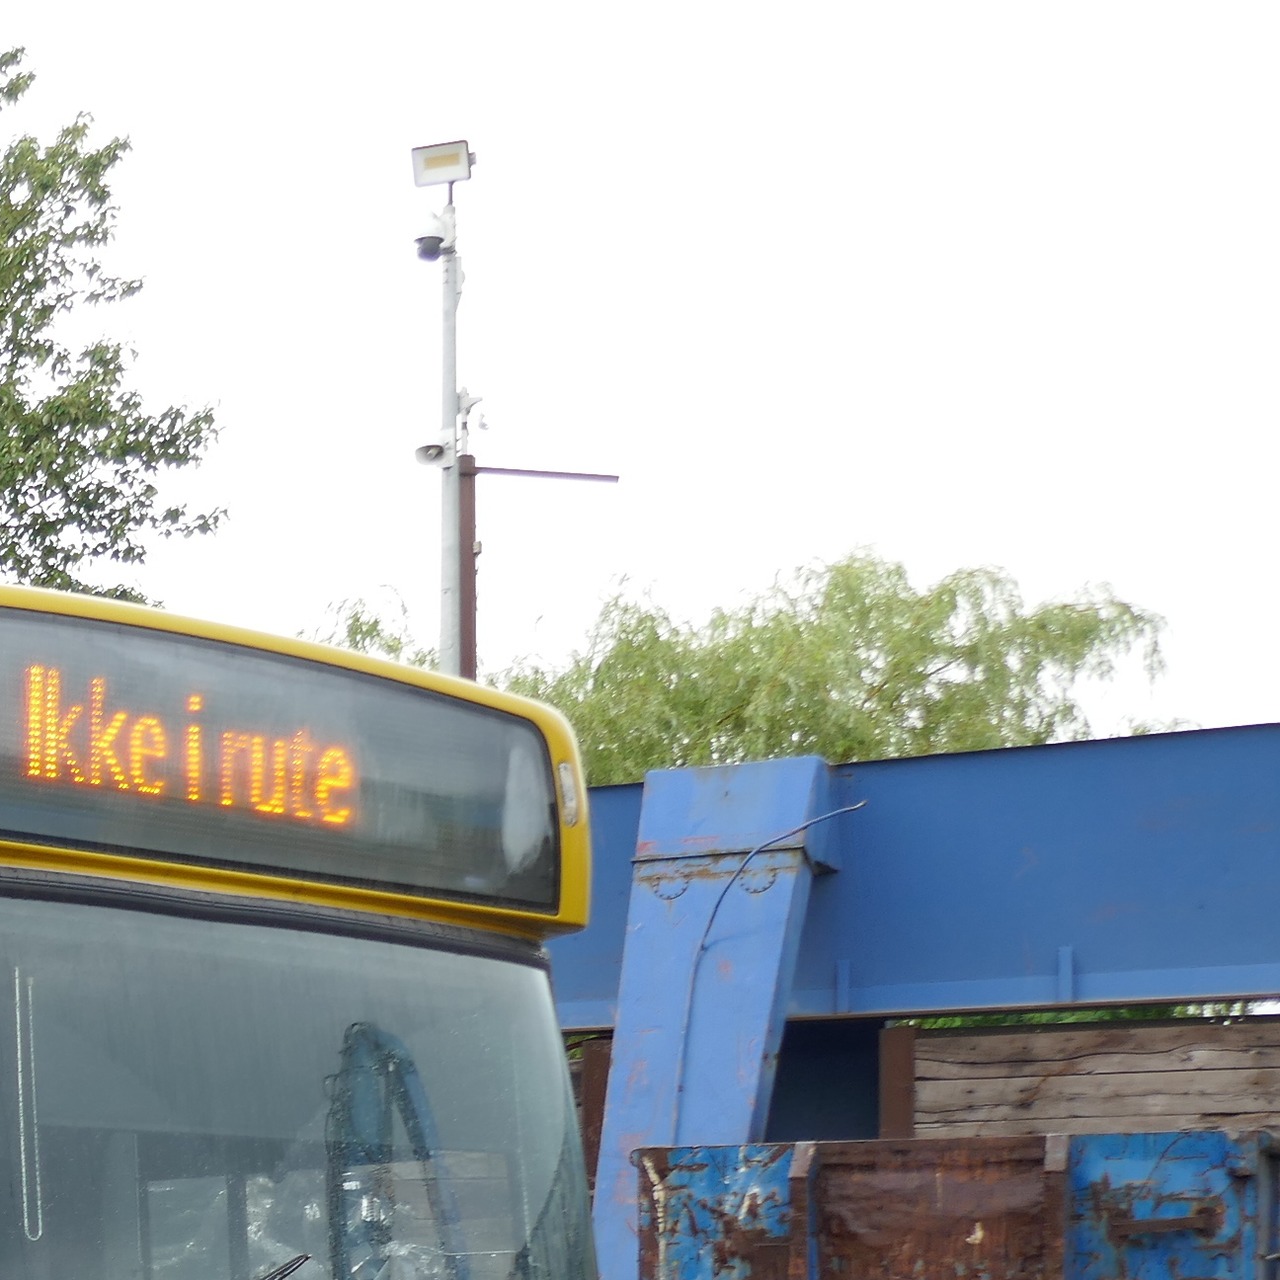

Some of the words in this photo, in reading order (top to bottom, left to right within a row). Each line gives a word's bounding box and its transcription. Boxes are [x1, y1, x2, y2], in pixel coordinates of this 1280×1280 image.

[28, 664, 168, 795] Ikke
[186, 694, 204, 802] i
[222, 729, 355, 824] rute
